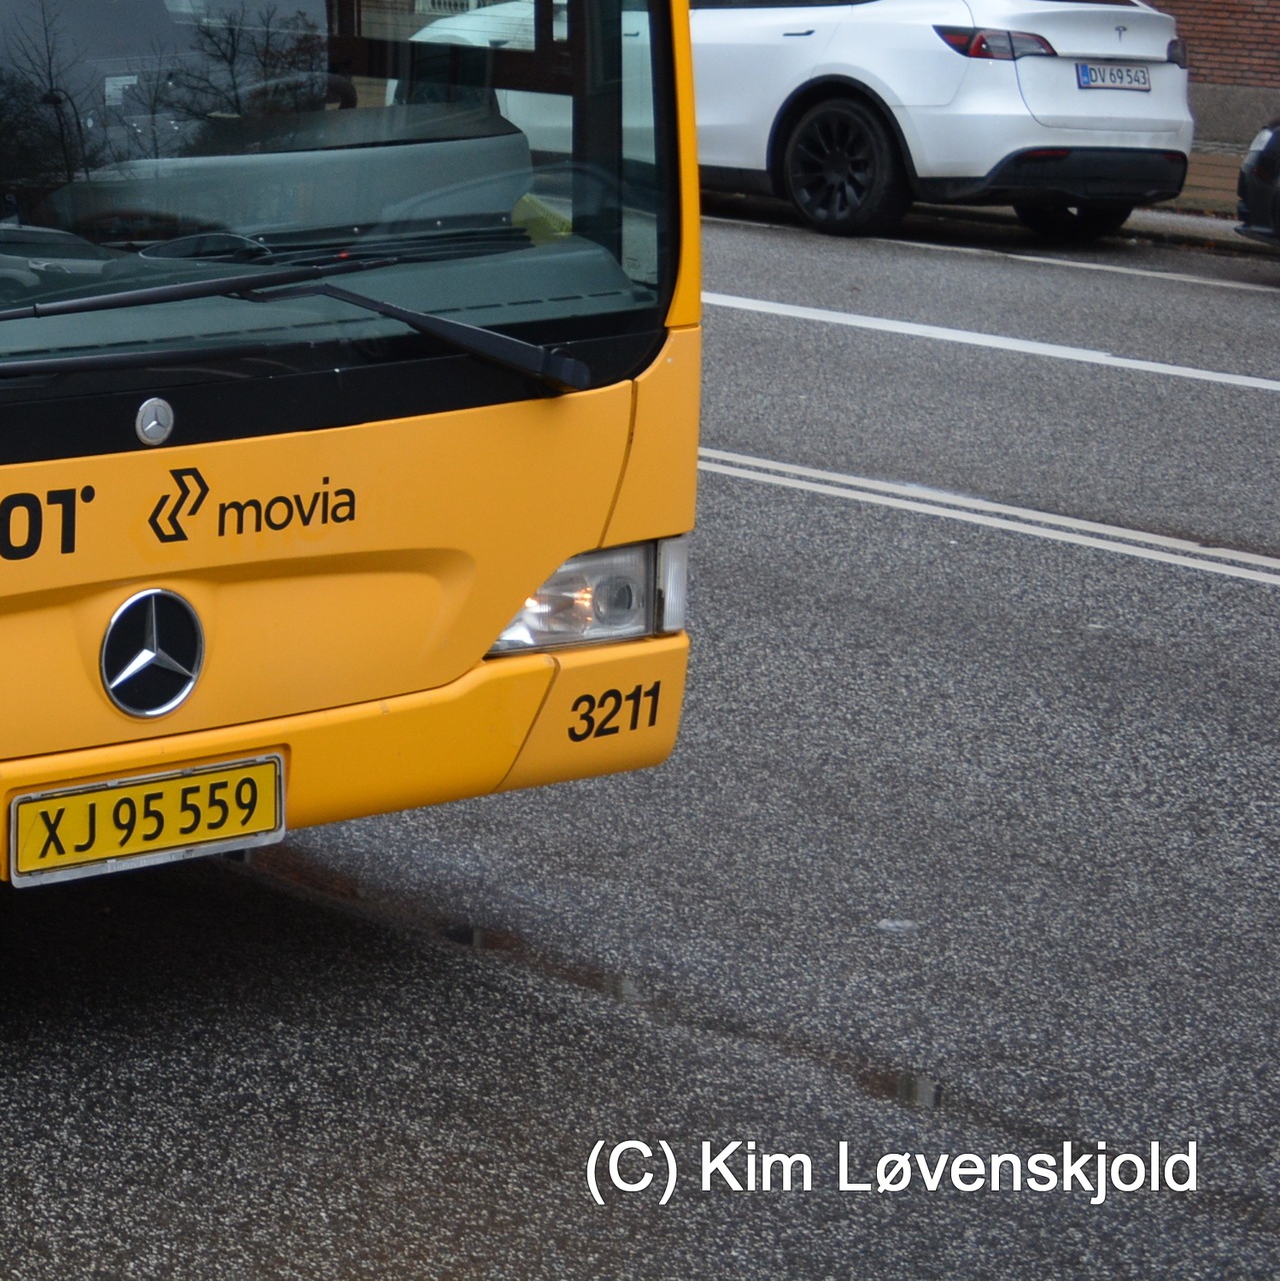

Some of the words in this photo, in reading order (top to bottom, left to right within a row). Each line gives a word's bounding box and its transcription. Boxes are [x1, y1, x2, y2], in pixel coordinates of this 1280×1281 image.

[1089, 67, 1106, 83] DV
[1109, 68, 1124, 84] 69
[1126, 69, 1147, 85] 543
[218, 476, 357, 537] movia
[567, 680, 662, 743] 3211
[38, 802, 97, 859] XJ
[112, 791, 166, 848] 95
[179, 777, 259, 836] 559
